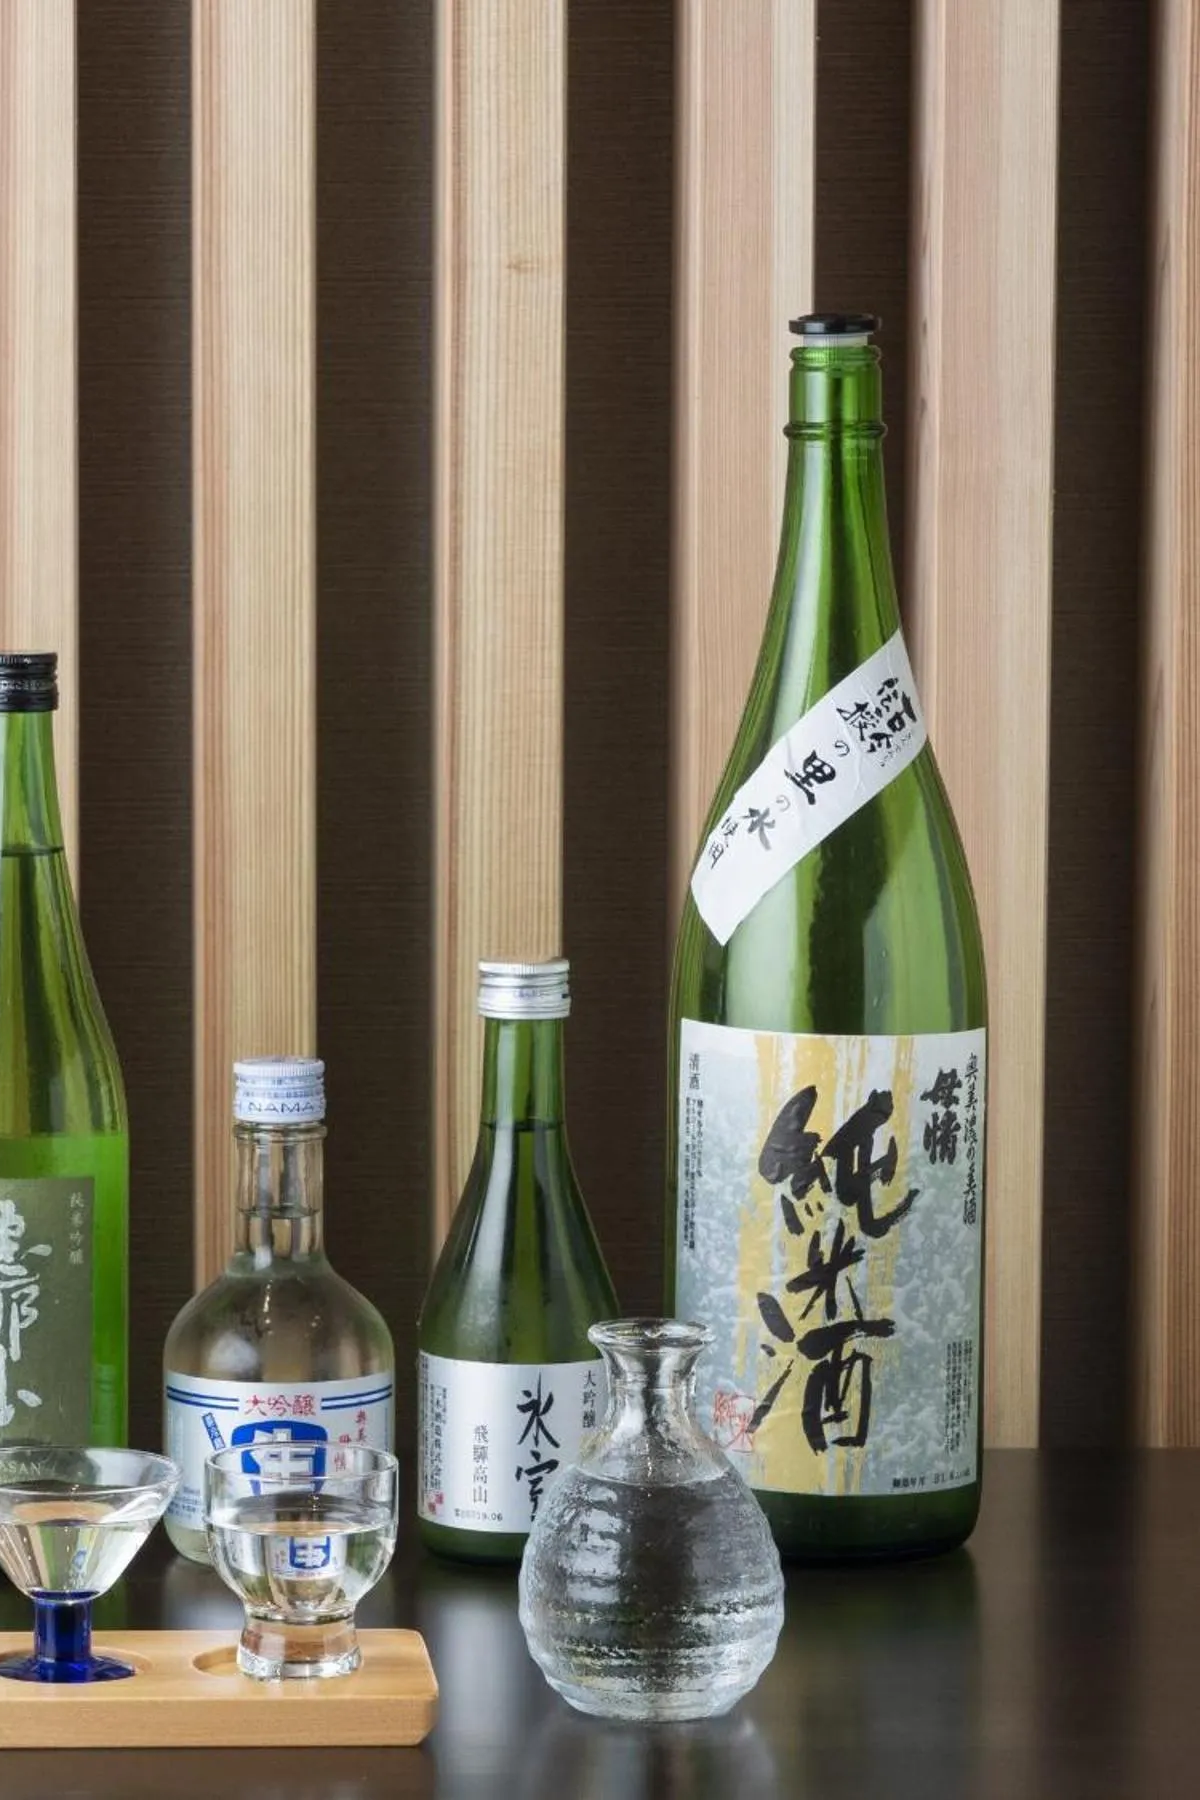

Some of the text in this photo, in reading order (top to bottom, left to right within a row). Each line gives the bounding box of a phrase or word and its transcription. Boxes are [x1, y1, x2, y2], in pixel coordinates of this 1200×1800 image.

[248, 1102, 314, 1113] NAMA
[920, 1068, 962, 1165] 母情
[747, 1085, 919, 1456] 純米酒
[244, 1394, 317, 1416] 大吟醸
[583, 1370, 596, 1428] 大吟醸
